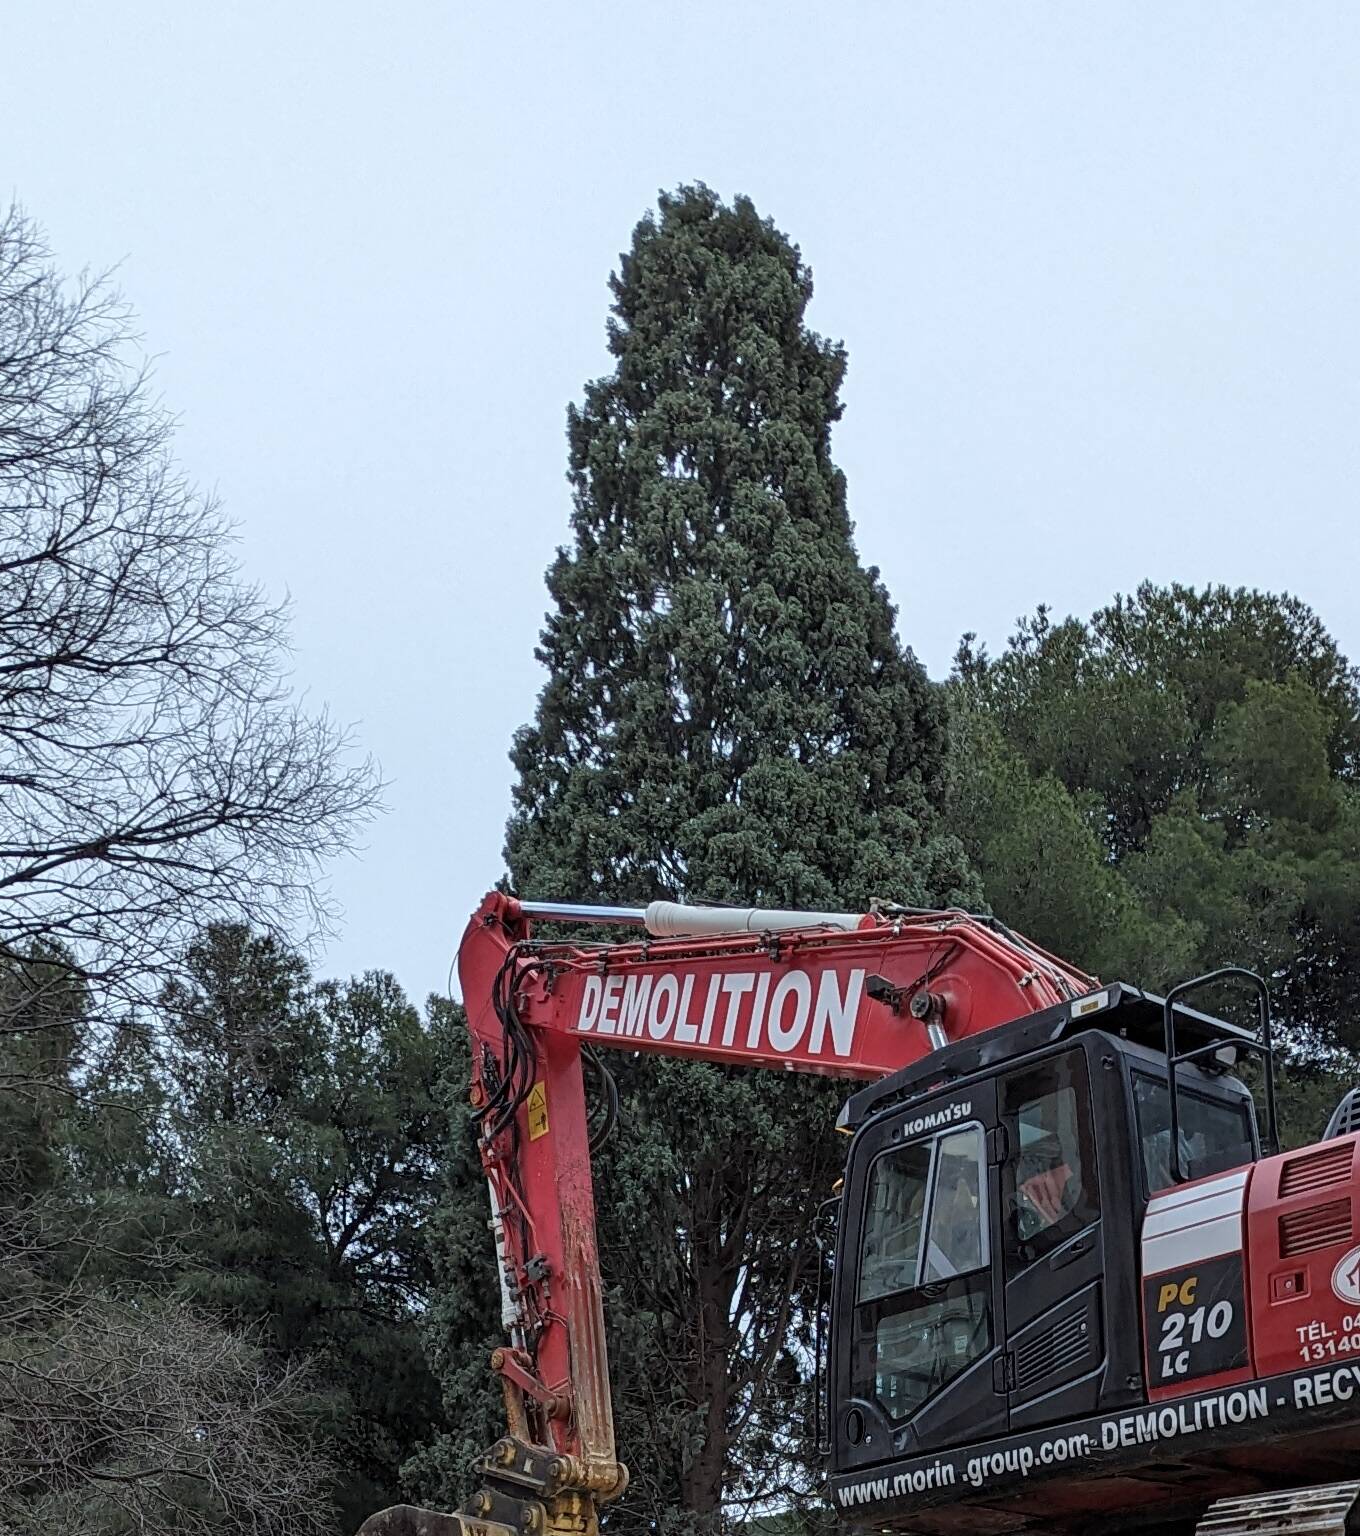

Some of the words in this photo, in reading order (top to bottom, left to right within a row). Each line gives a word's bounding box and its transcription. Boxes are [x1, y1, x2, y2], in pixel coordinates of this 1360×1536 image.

[577, 968, 865, 1057] DEMOLITION
[903, 1101, 972, 1137] KOMATSU
[1158, 1277, 1198, 1313] PC
[1158, 1301, 1233, 1352] 210
[1296, 1320, 1338, 1344] TÉL.
[1161, 1351, 1190, 1378] LC
[838, 1460, 956, 1507] www.morin
[1101, 1387, 1269, 1450] DEMOLITION
